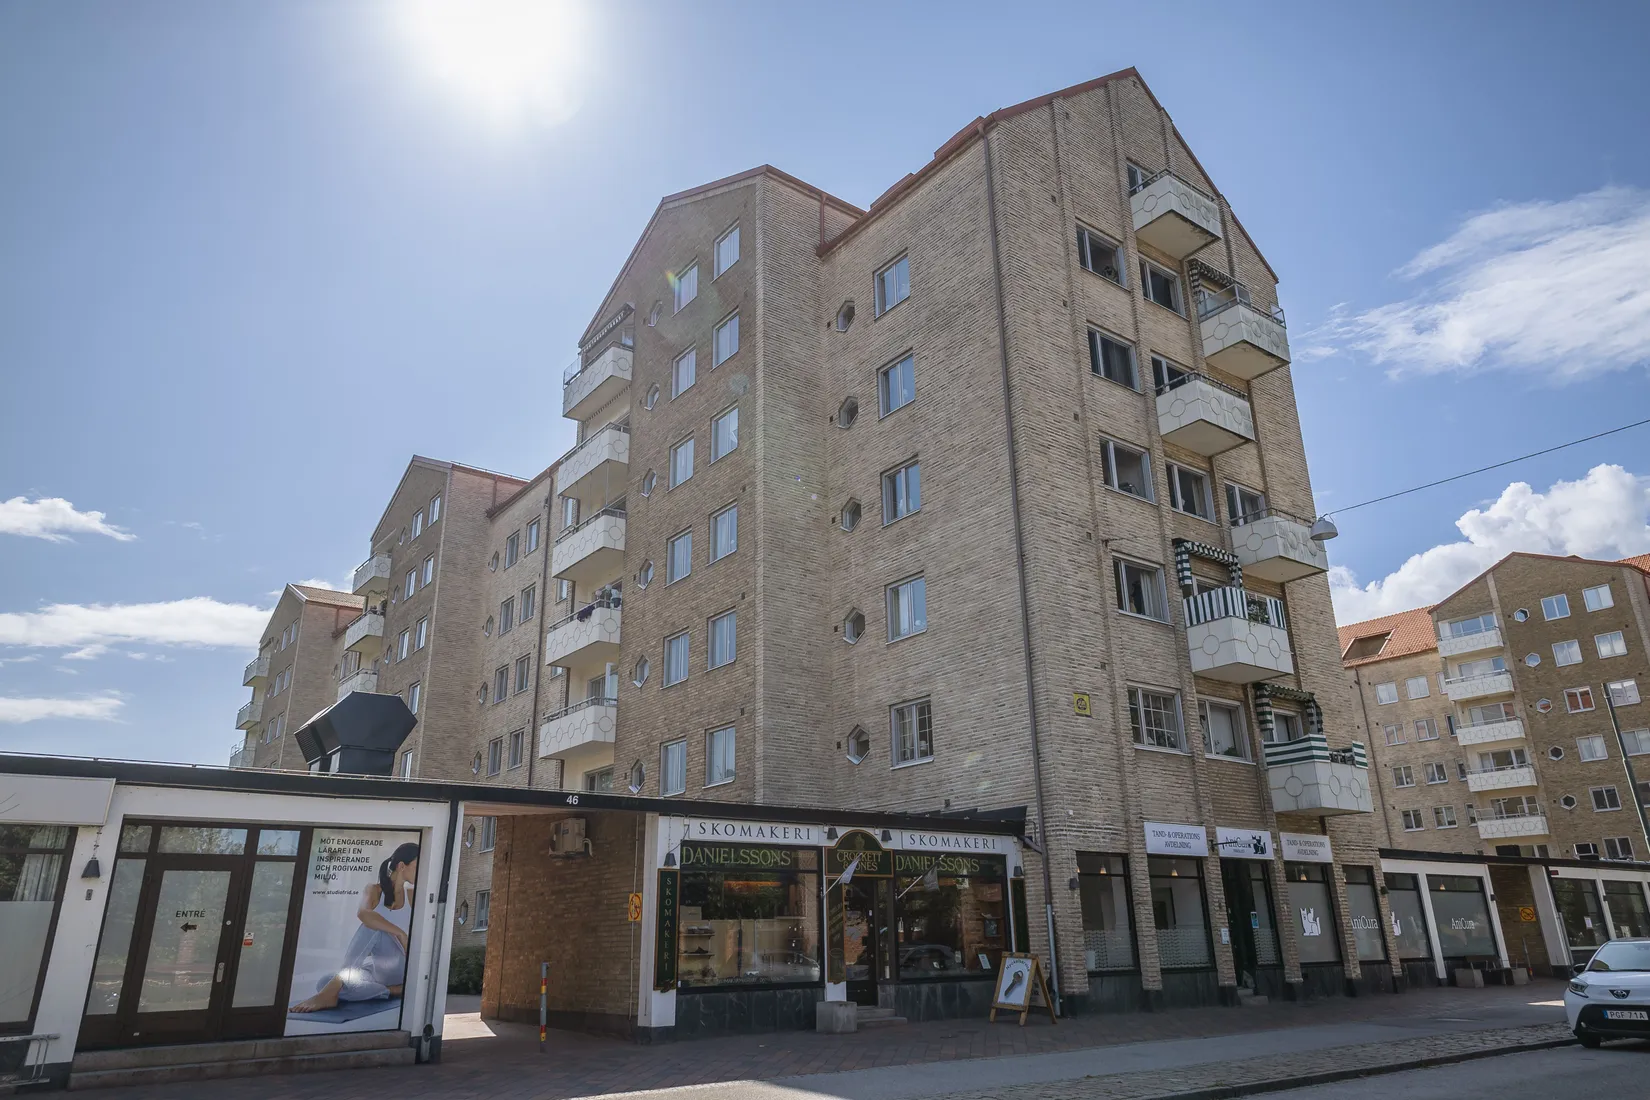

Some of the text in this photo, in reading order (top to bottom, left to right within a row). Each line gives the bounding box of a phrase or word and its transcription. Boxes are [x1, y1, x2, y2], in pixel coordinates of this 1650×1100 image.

[566, 795, 579, 805] 46
[698, 822, 811, 840] SKOMAKERI
[1172, 831, 1201, 841] OPERATIONS
[320, 837, 384, 847] MÖT ENGAGERADE
[909, 834, 996, 850] SKOMAKERI
[1164, 841, 1192, 849] AVDELNING
[318, 846, 347, 854] LÄRARE
[316, 855, 371, 863] INSPIRERANDE
[681, 846, 791, 867] DANIELSSONS
[851, 861, 878, 872] ONES
[895, 854, 980, 872] DANIELSSONS
[175, 908, 206, 918] ENTRÉ
[663, 878, 672, 971] SKOMAKERI
[1451, 917, 1475, 930] AniCura
